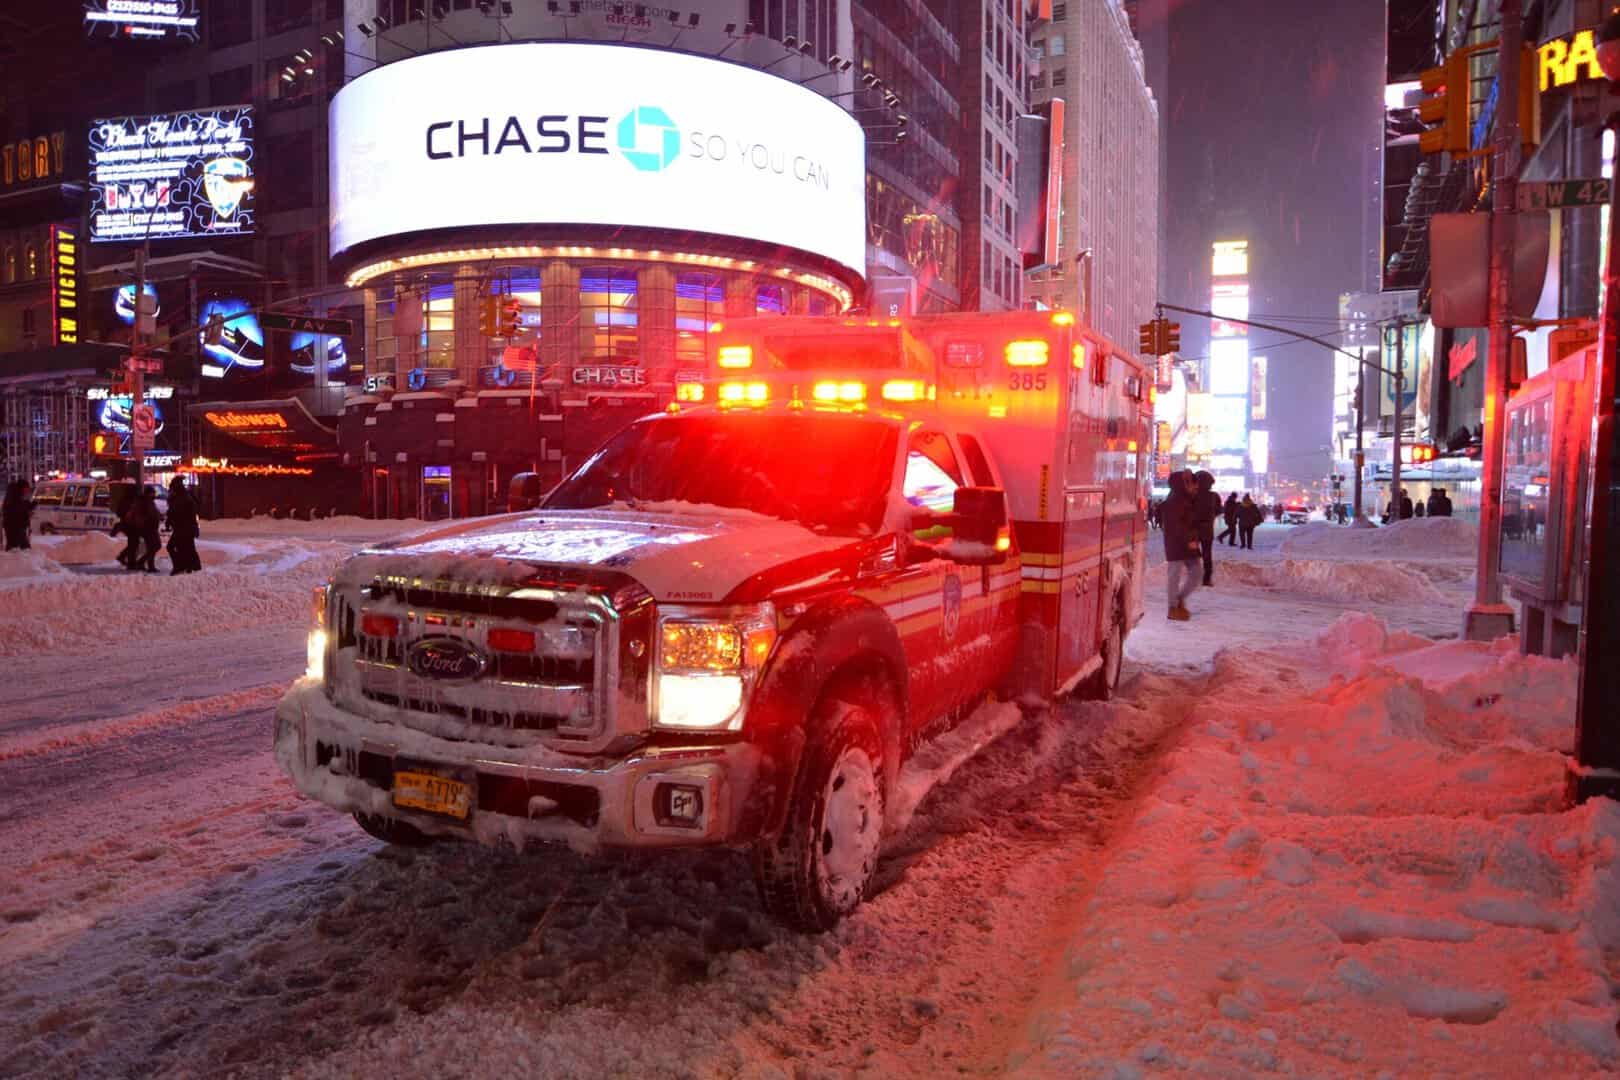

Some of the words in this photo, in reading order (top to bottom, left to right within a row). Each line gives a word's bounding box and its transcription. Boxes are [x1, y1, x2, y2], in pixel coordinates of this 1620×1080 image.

[607, 14, 652, 27] RICOH
[426, 115, 609, 160] CHASE
[3, 132, 64, 185] TORY
[689, 131, 727, 161] SO
[736, 140, 784, 175] YOU
[793, 155, 829, 191] CAN
[1576, 181, 1609, 203] 42
[58, 229, 76, 308] VICTORY
[303, 321, 326, 332] AV
[572, 367, 646, 385] CHASE
[1009, 372, 1048, 392] 385
[420, 650, 463, 674] Ford
